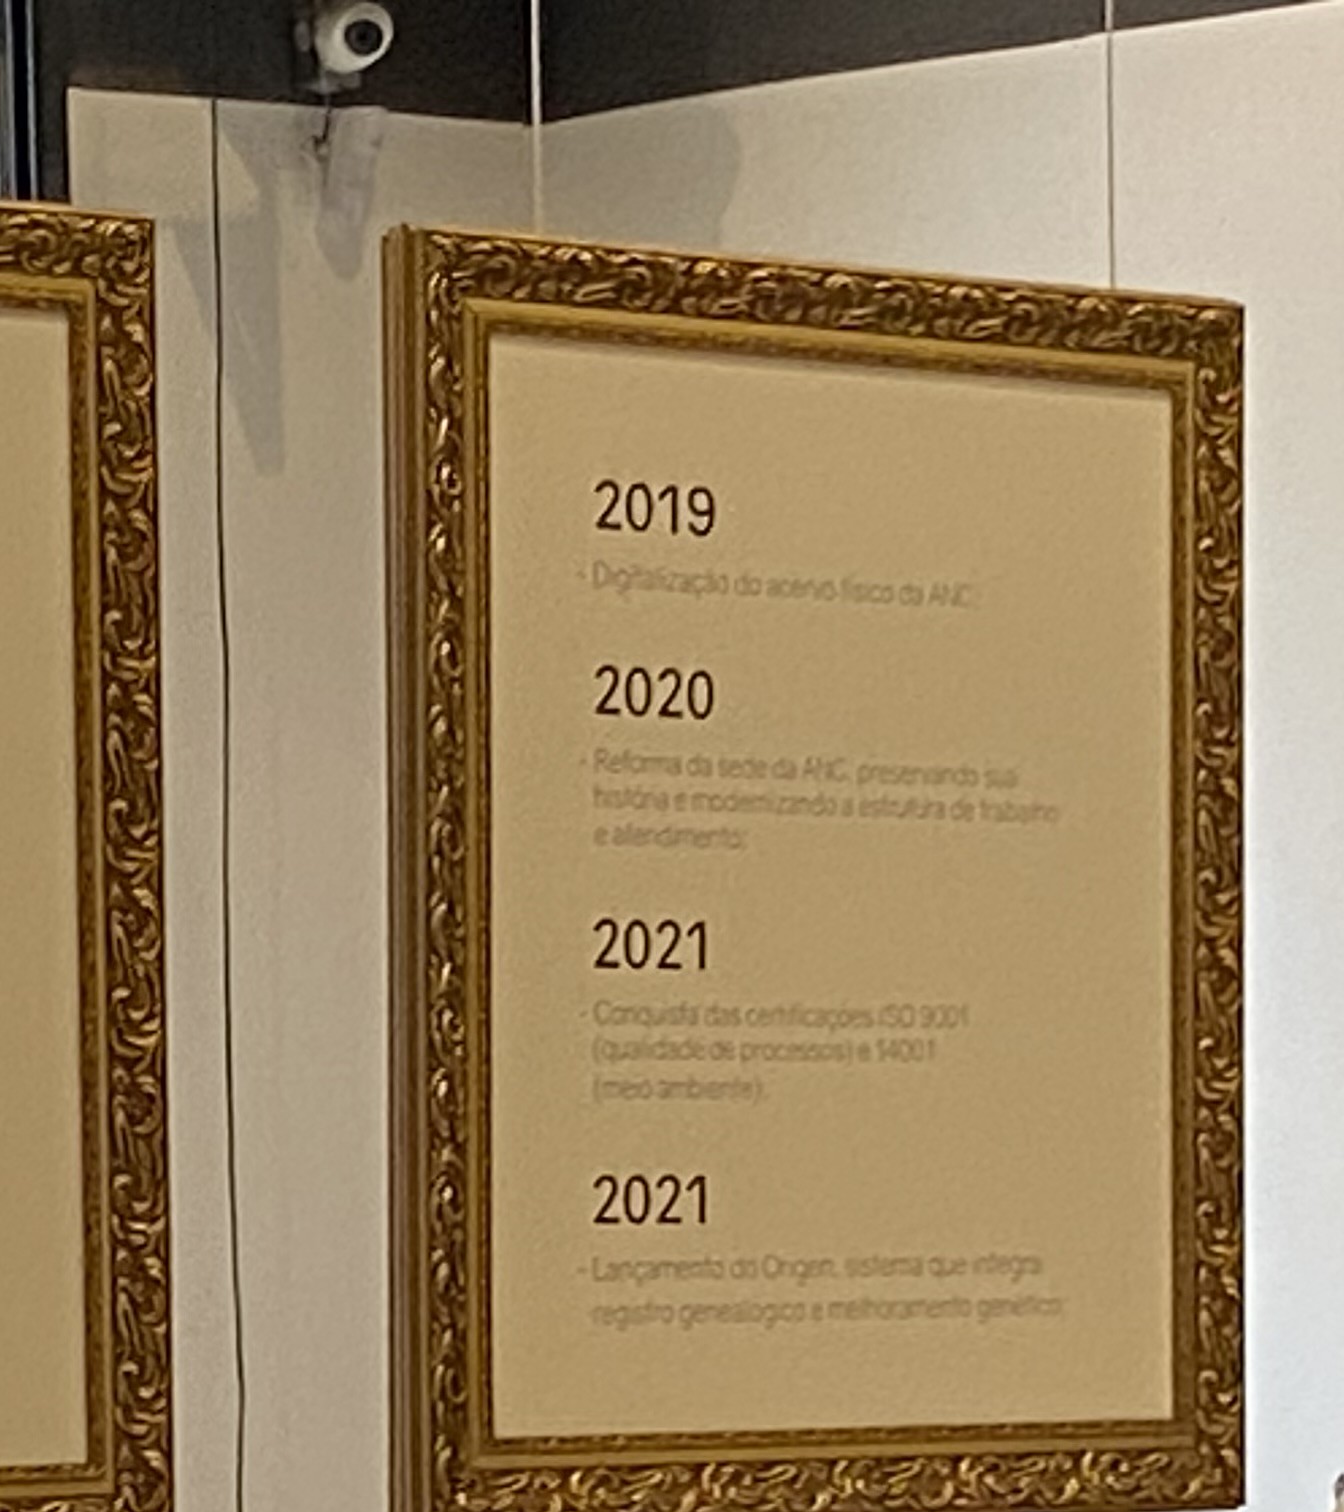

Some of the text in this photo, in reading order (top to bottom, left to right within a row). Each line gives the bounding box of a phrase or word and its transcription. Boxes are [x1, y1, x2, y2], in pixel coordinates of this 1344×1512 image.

[593, 479, 716, 537] 2019
[593, 664, 716, 721] 2020
[592, 918, 709, 971] 2021
[592, 1173, 709, 1226] 2021
